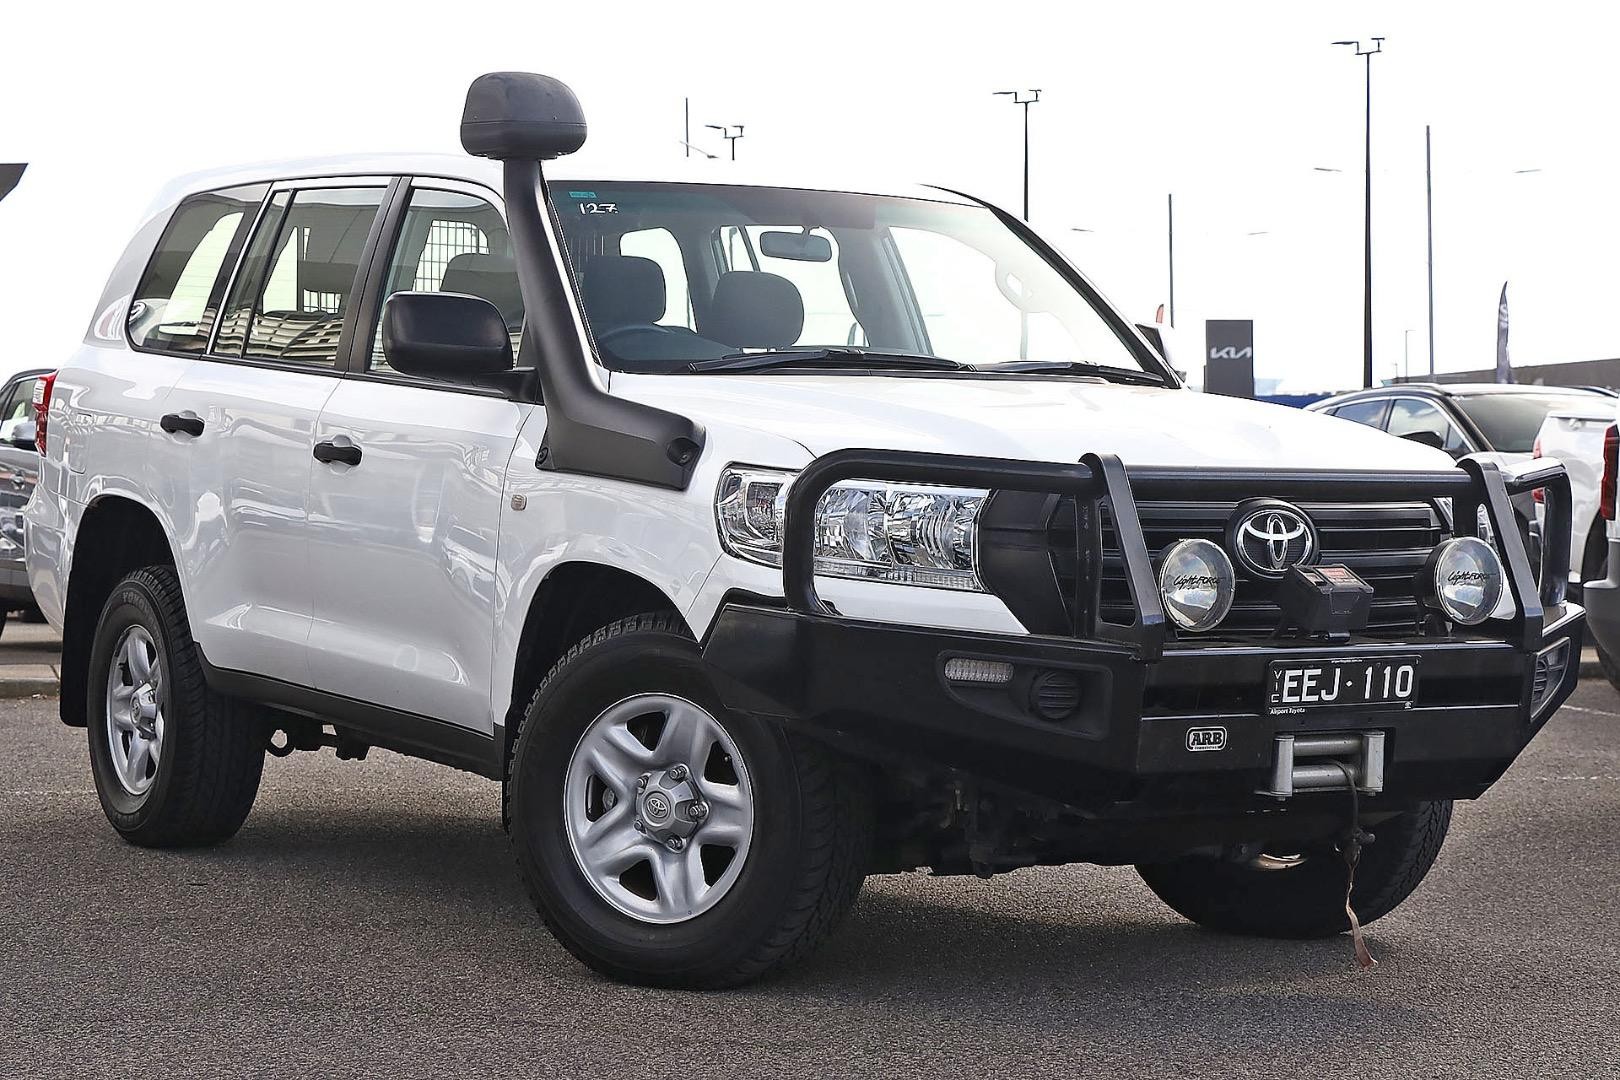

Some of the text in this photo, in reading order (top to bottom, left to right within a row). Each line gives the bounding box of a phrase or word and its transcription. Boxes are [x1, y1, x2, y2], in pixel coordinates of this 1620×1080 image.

[1210, 346, 1252, 359] KIA
[1271, 669, 1283, 703] VIC
[1269, 707, 1289, 716] Airport
[1191, 731, 1223, 746] ARB
